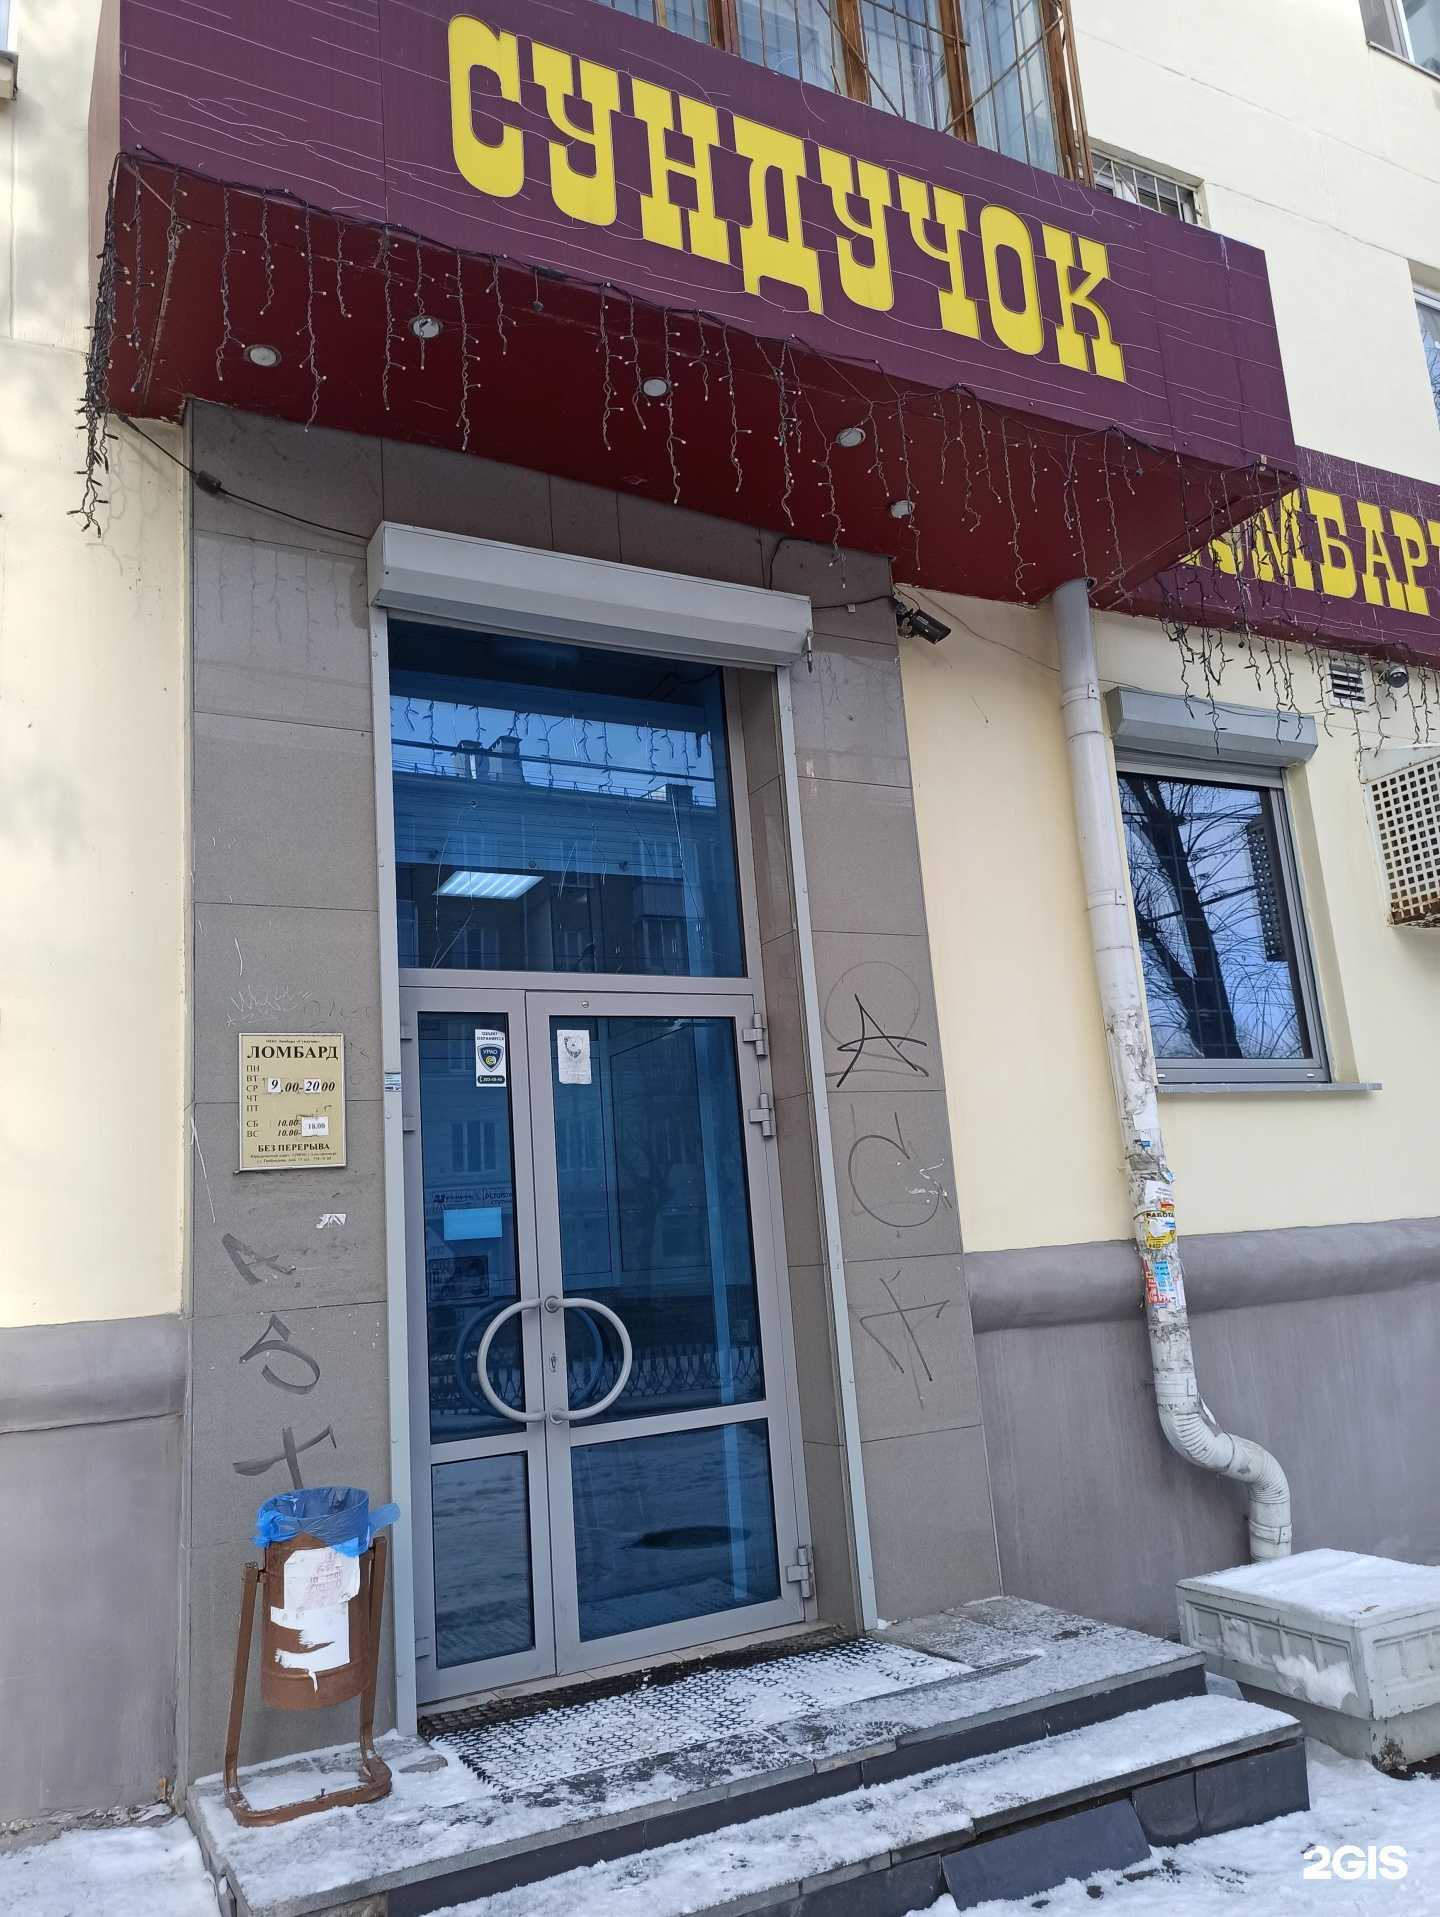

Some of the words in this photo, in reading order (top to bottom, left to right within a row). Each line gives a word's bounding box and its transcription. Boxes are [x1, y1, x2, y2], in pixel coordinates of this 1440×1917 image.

[447, 14, 1127, 382] СУНДУЧОК
[247, 1046, 339, 1061] ЛОМБАРД
[246, 1120, 259, 1128] СБ
[258, 1144, 276, 1153] БЕЗ
[278, 1143, 330, 1152] ПЕРЕРЫВА
